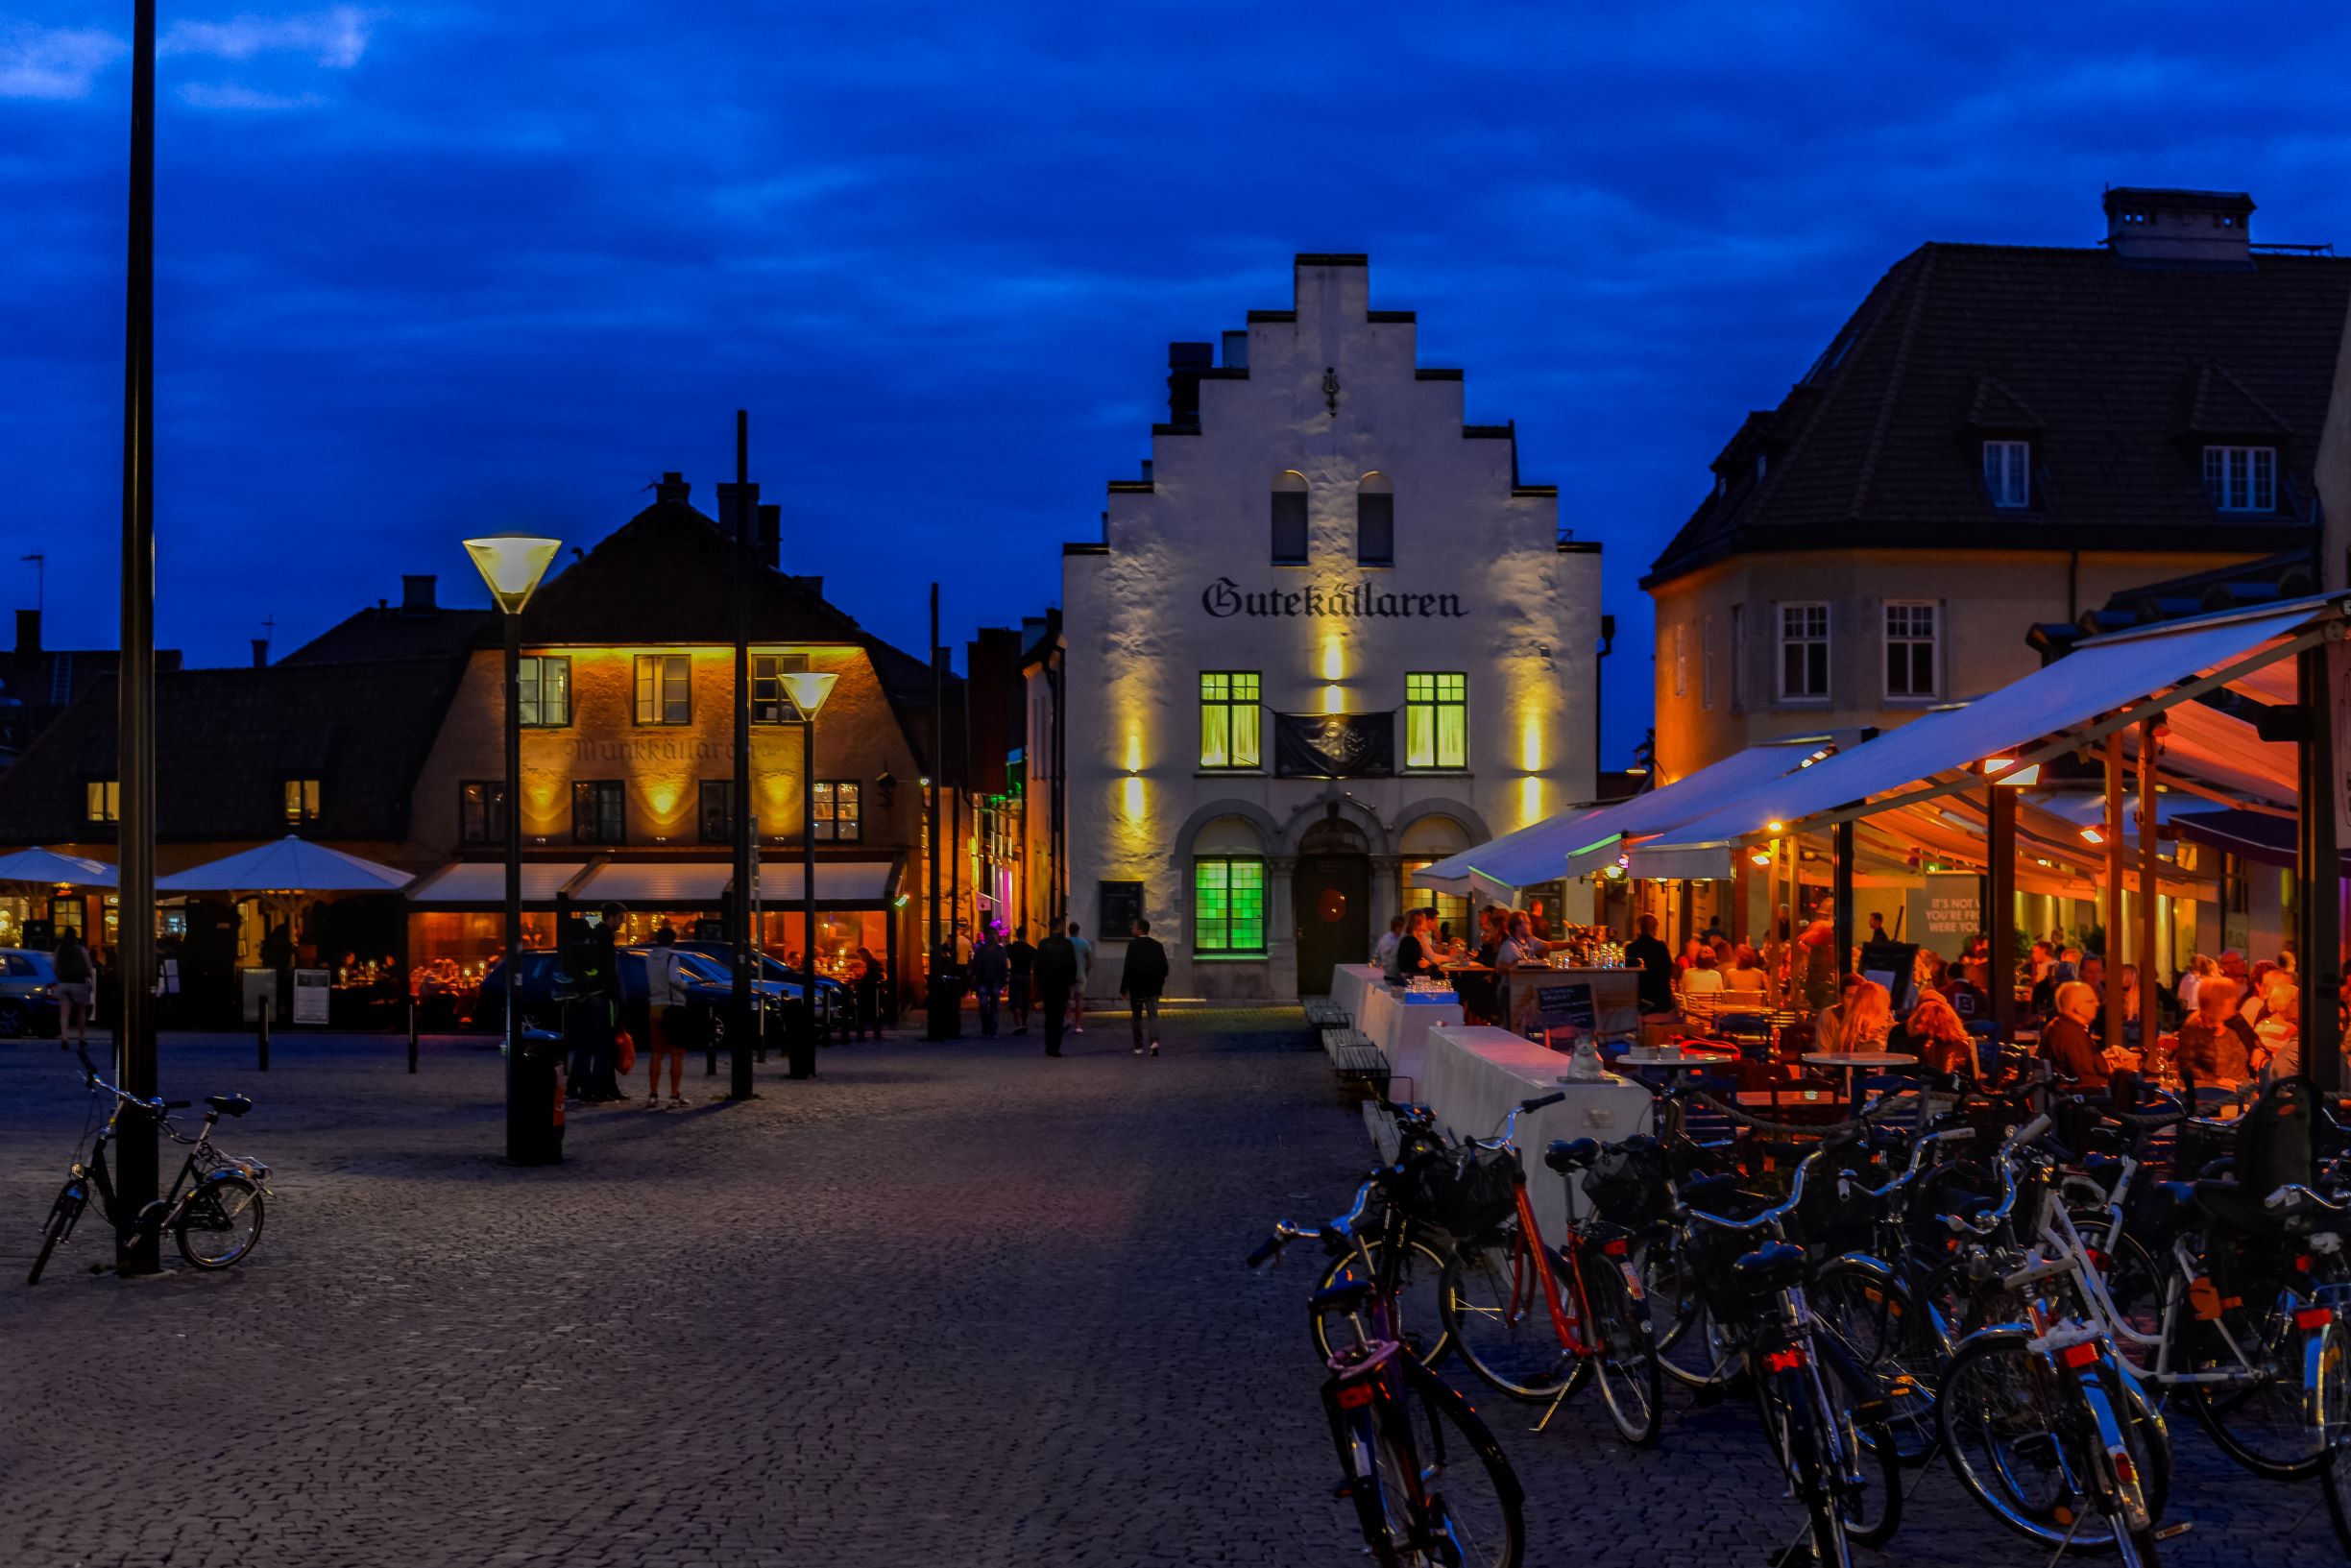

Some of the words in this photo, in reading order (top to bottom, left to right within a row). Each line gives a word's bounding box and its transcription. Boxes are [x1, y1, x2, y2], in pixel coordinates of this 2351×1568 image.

[1202, 576, 1470, 617] Gutekällaren
[1951, 899, 1973, 909] NOT
[1925, 910, 1962, 921] YOU'RE
[1928, 922, 1956, 932] WERE
